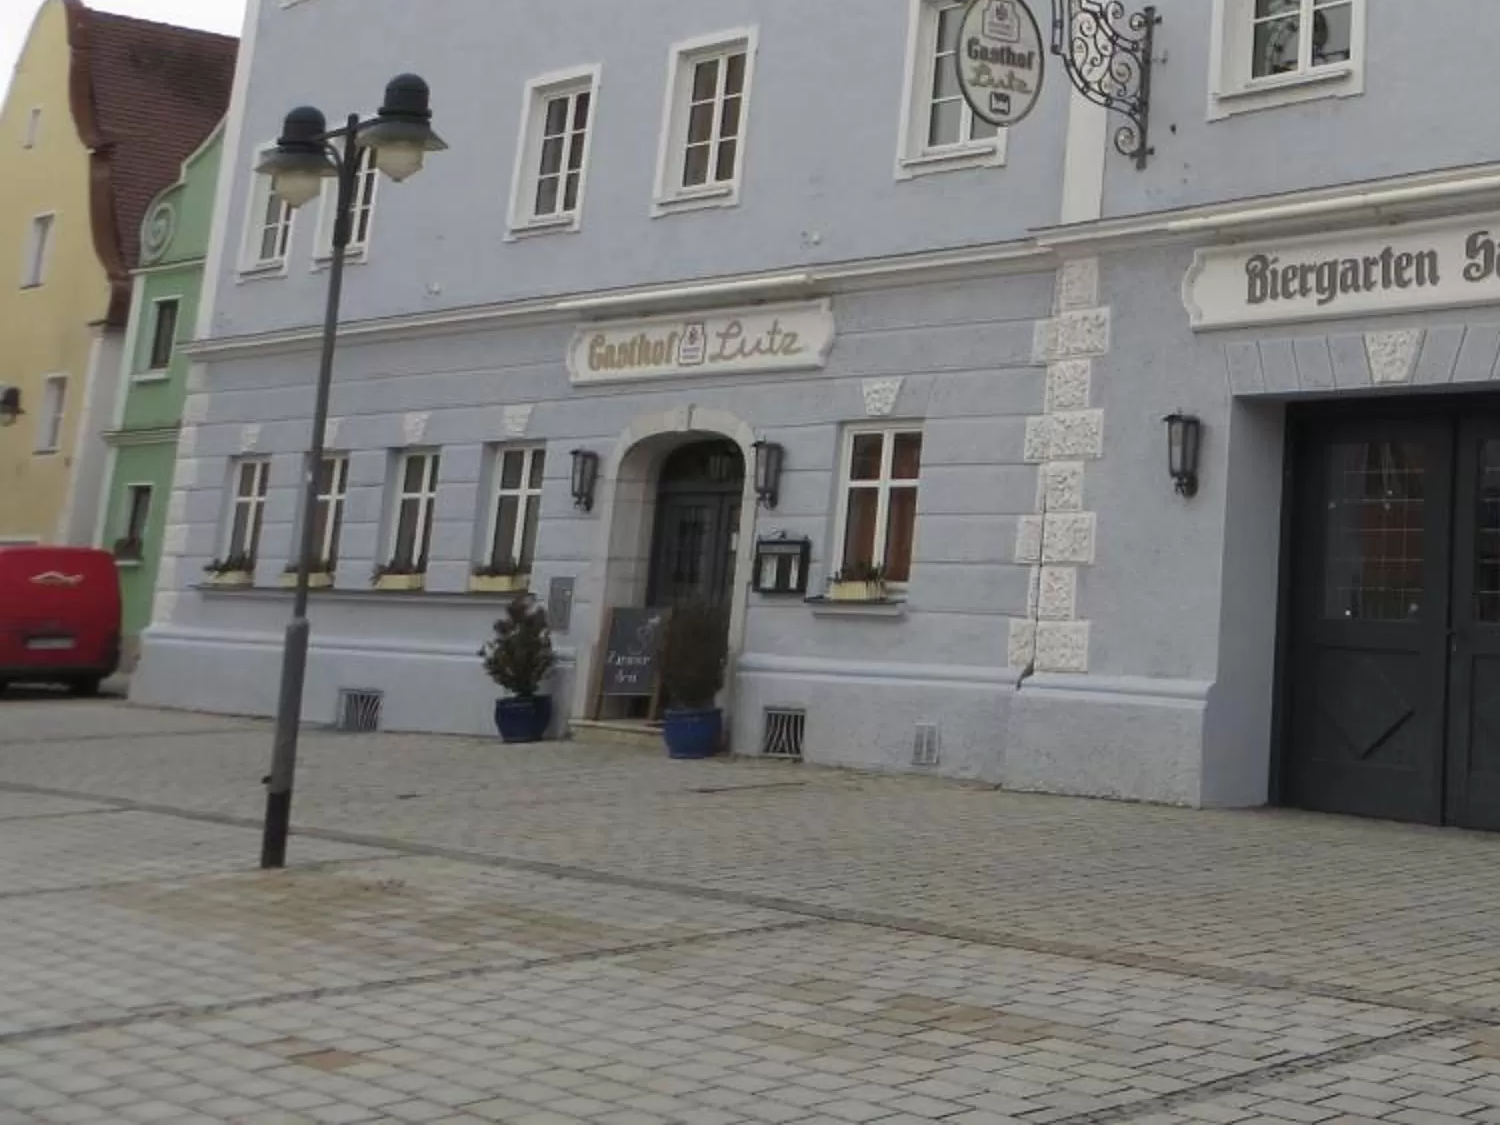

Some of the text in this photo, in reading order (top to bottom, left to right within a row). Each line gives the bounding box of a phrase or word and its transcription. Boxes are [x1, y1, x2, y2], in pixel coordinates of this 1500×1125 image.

[967, 36, 1035, 70] Gasthof
[1246, 246, 1440, 306] Biergarten
[588, 318, 802, 372] Gasthof Lutz
